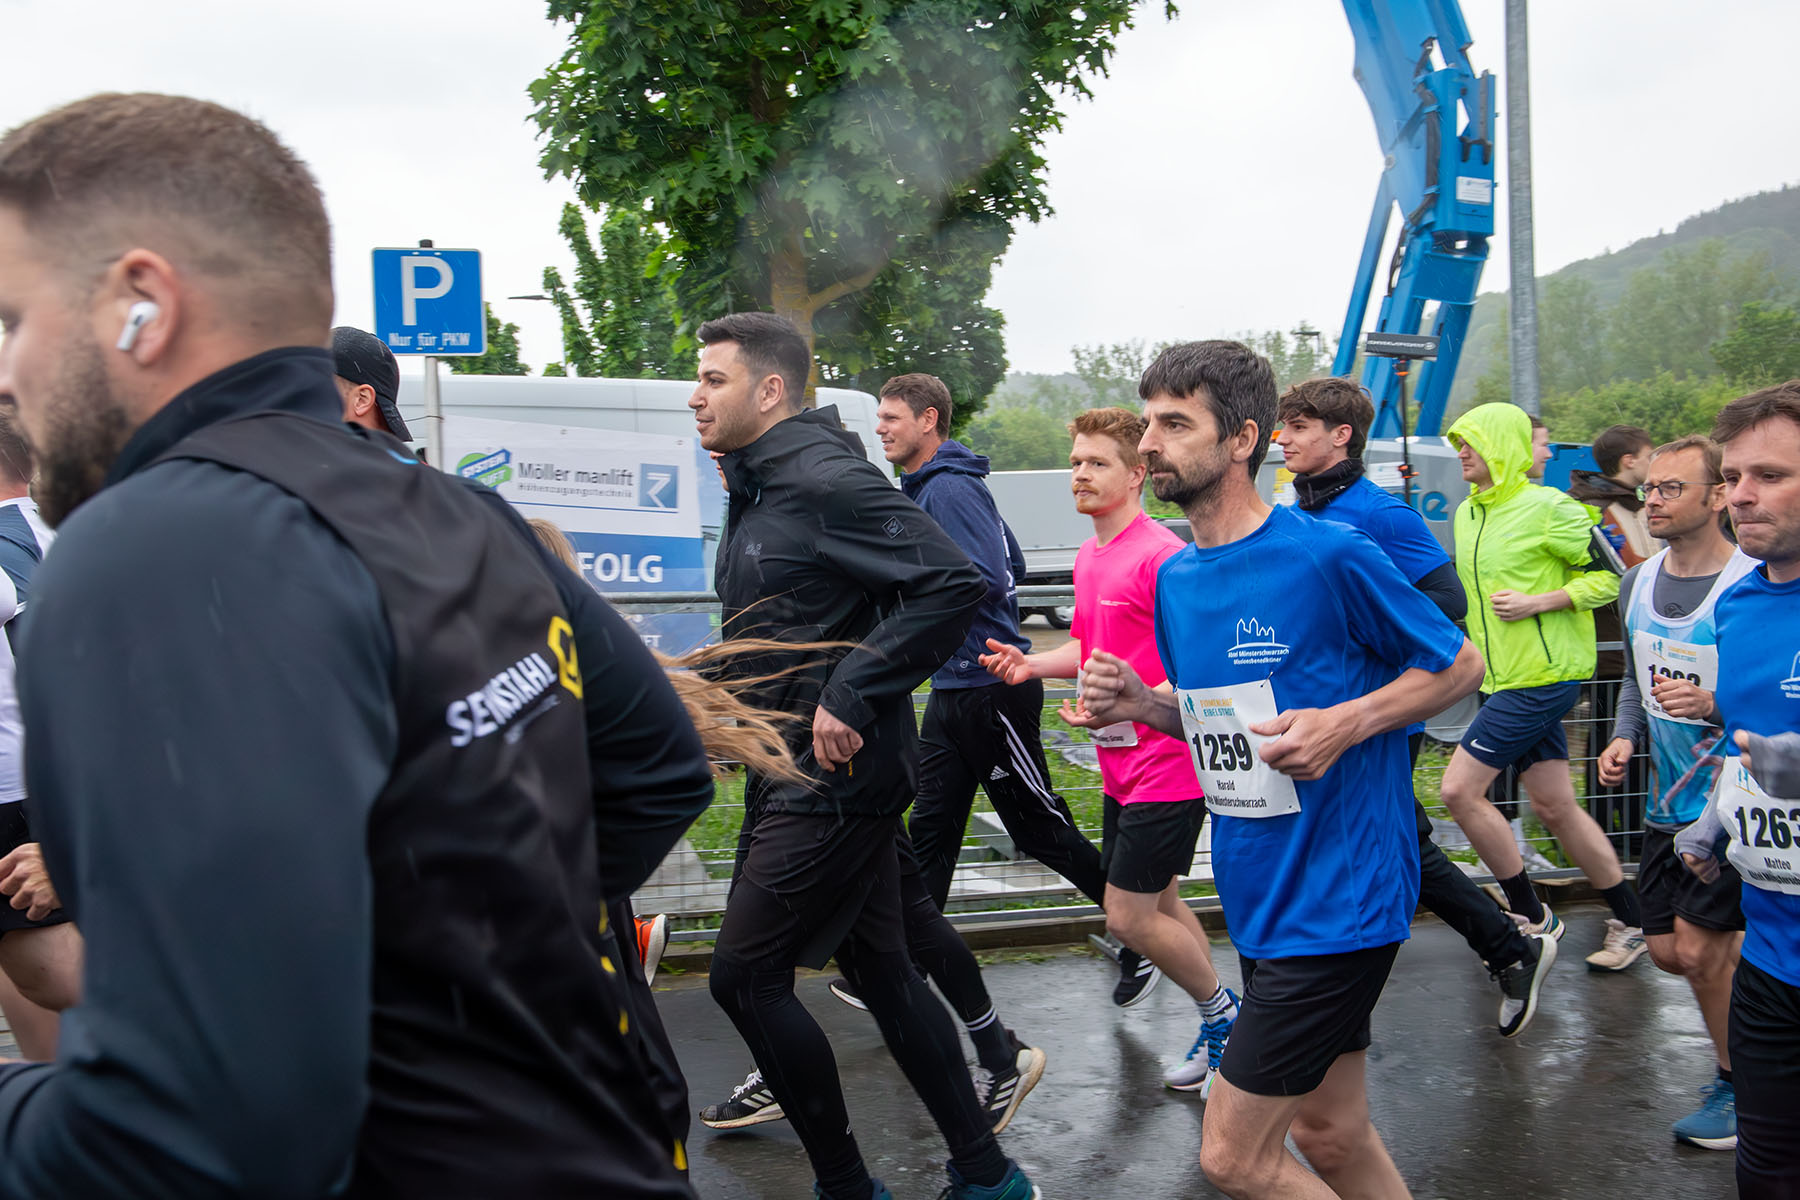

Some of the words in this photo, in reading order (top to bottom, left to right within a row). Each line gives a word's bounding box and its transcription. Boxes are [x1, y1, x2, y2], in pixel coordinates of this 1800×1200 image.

[401, 256, 454, 325] P
[388, 332, 412, 347] Nur
[417, 332, 437, 347] für
[441, 332, 470, 347] PKW
[517, 461, 570, 483] Möller
[574, 467, 634, 487] manlift
[1192, 732, 1254, 772] 1259
[1216, 779, 1236, 791] Harald
[1763, 856, 1792, 871] Matteo
